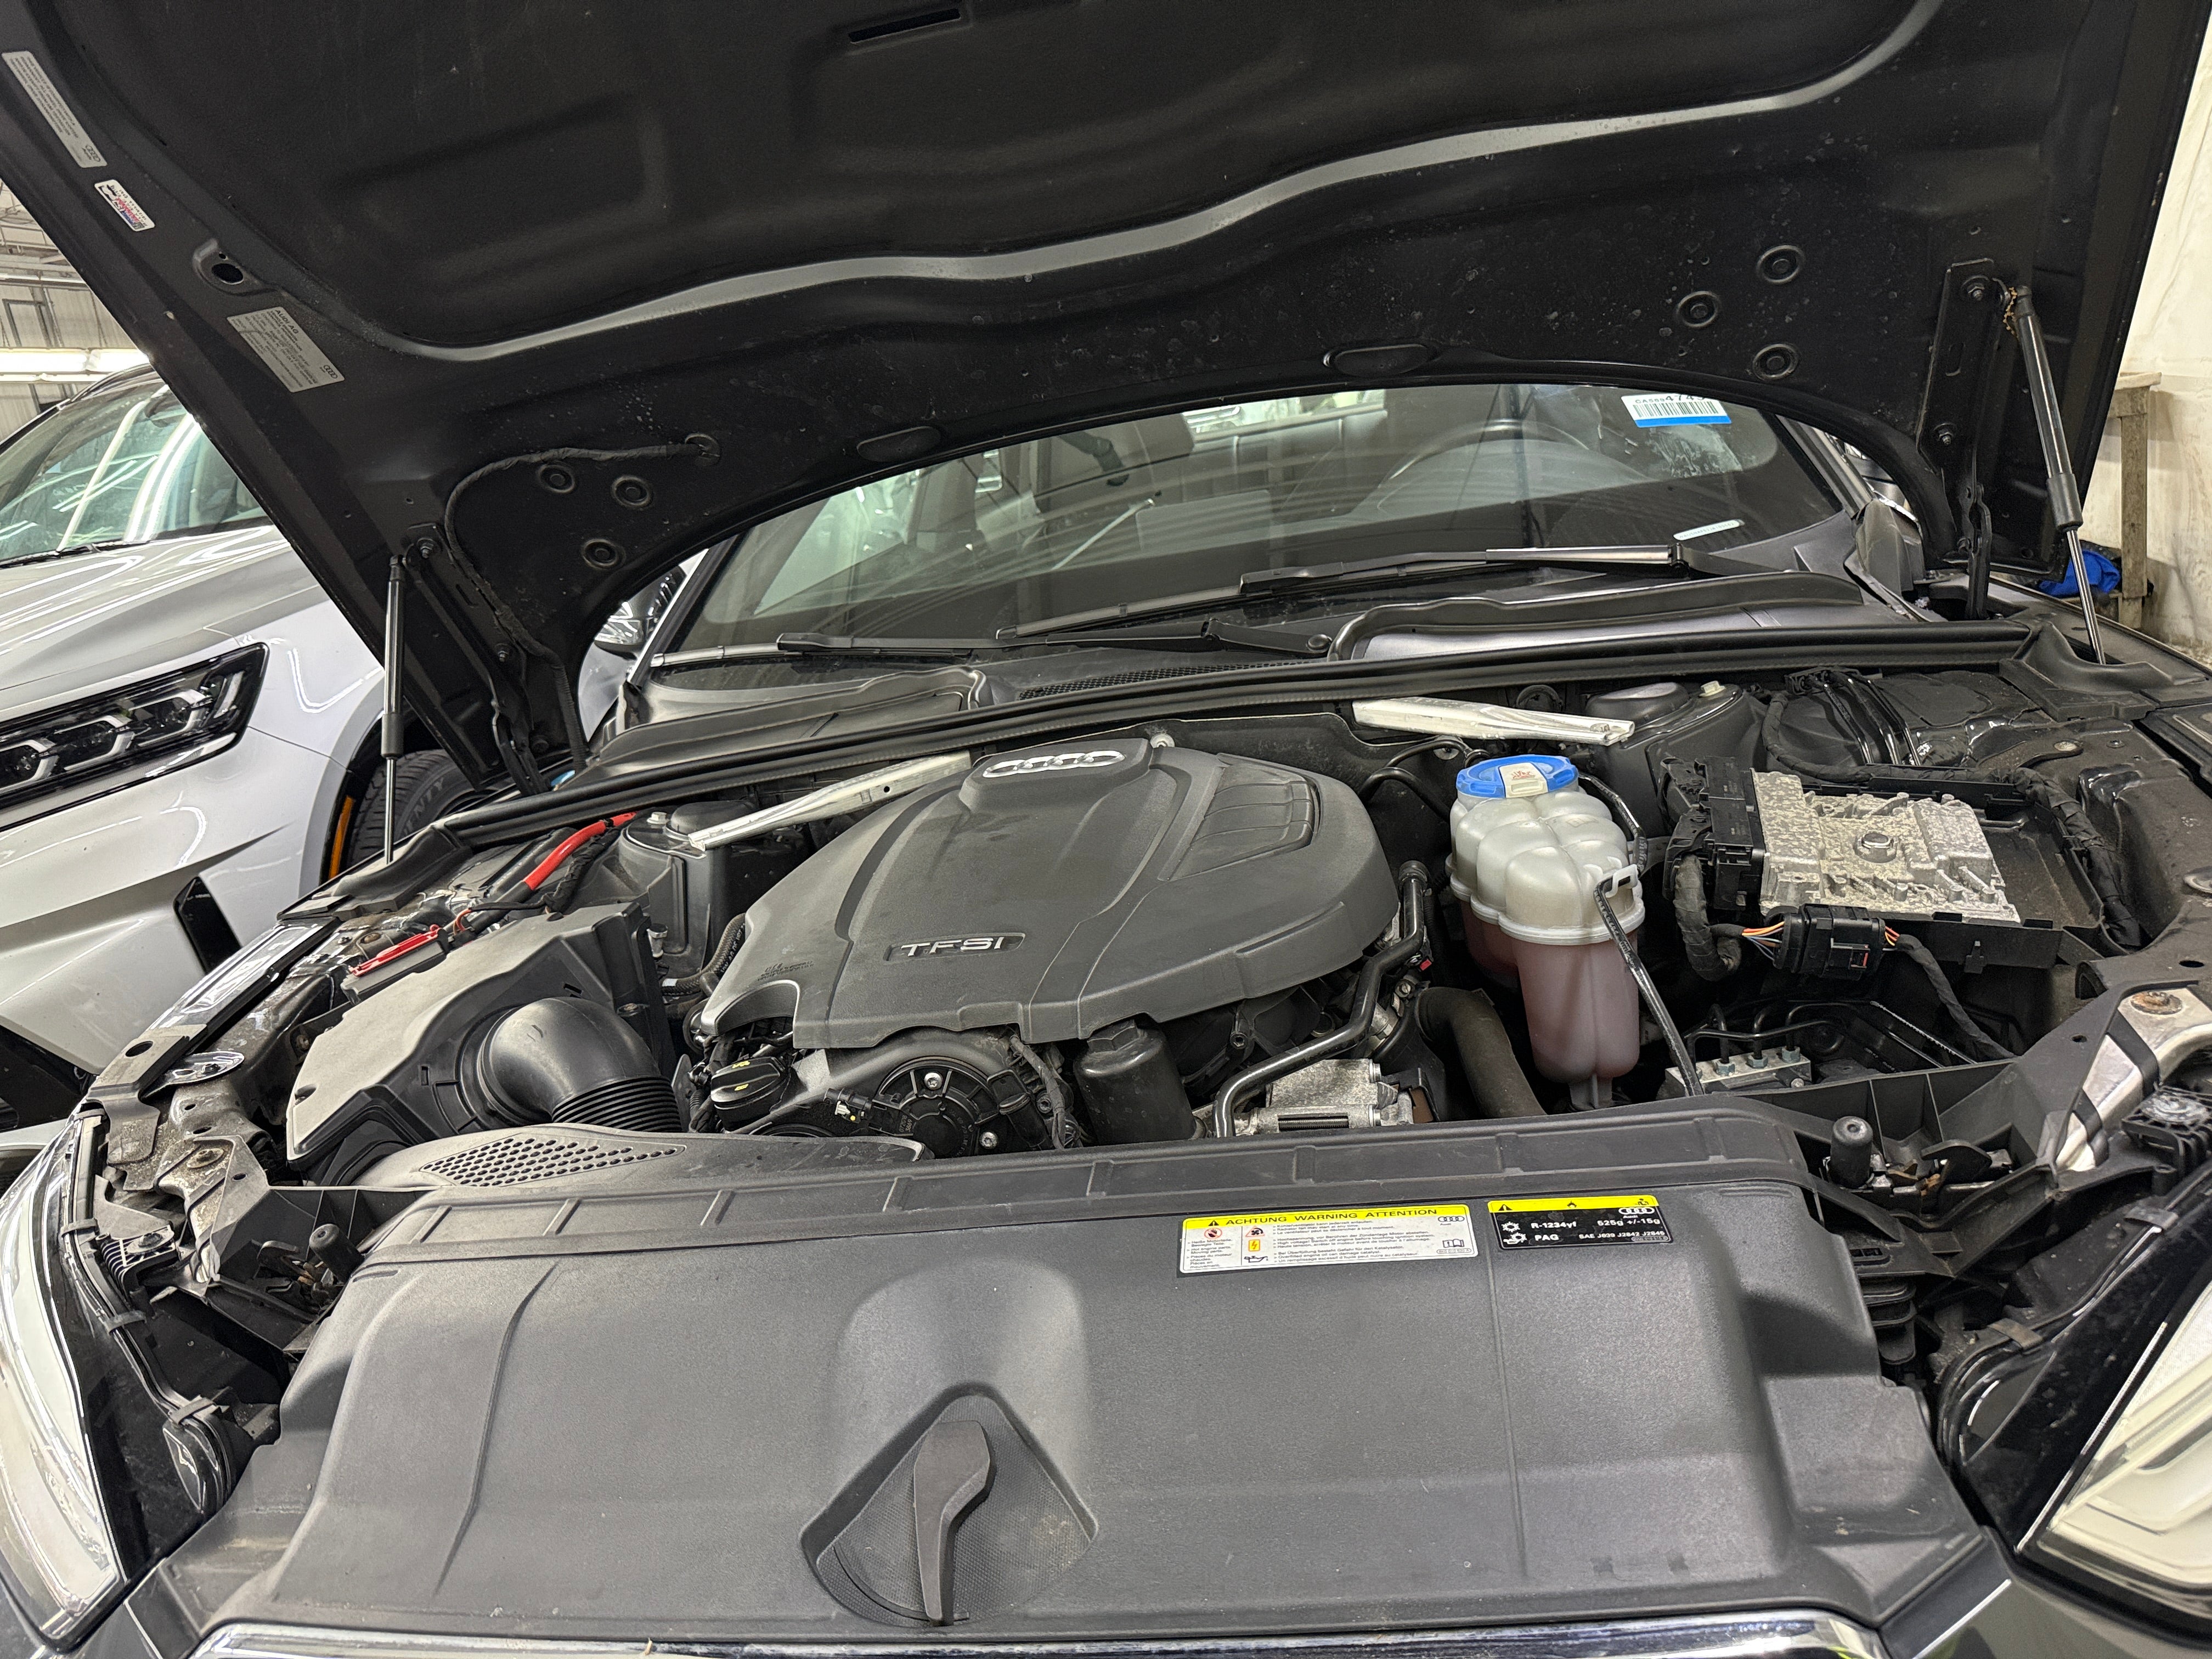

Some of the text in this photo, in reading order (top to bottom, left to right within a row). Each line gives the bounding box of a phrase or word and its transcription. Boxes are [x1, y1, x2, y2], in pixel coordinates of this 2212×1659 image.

[275, 309, 290, 324] AUDI
[288, 324, 299, 334] AG
[901, 936, 1005, 956] TFSI
[1226, 1216, 1287, 1225] ACHTUNG
